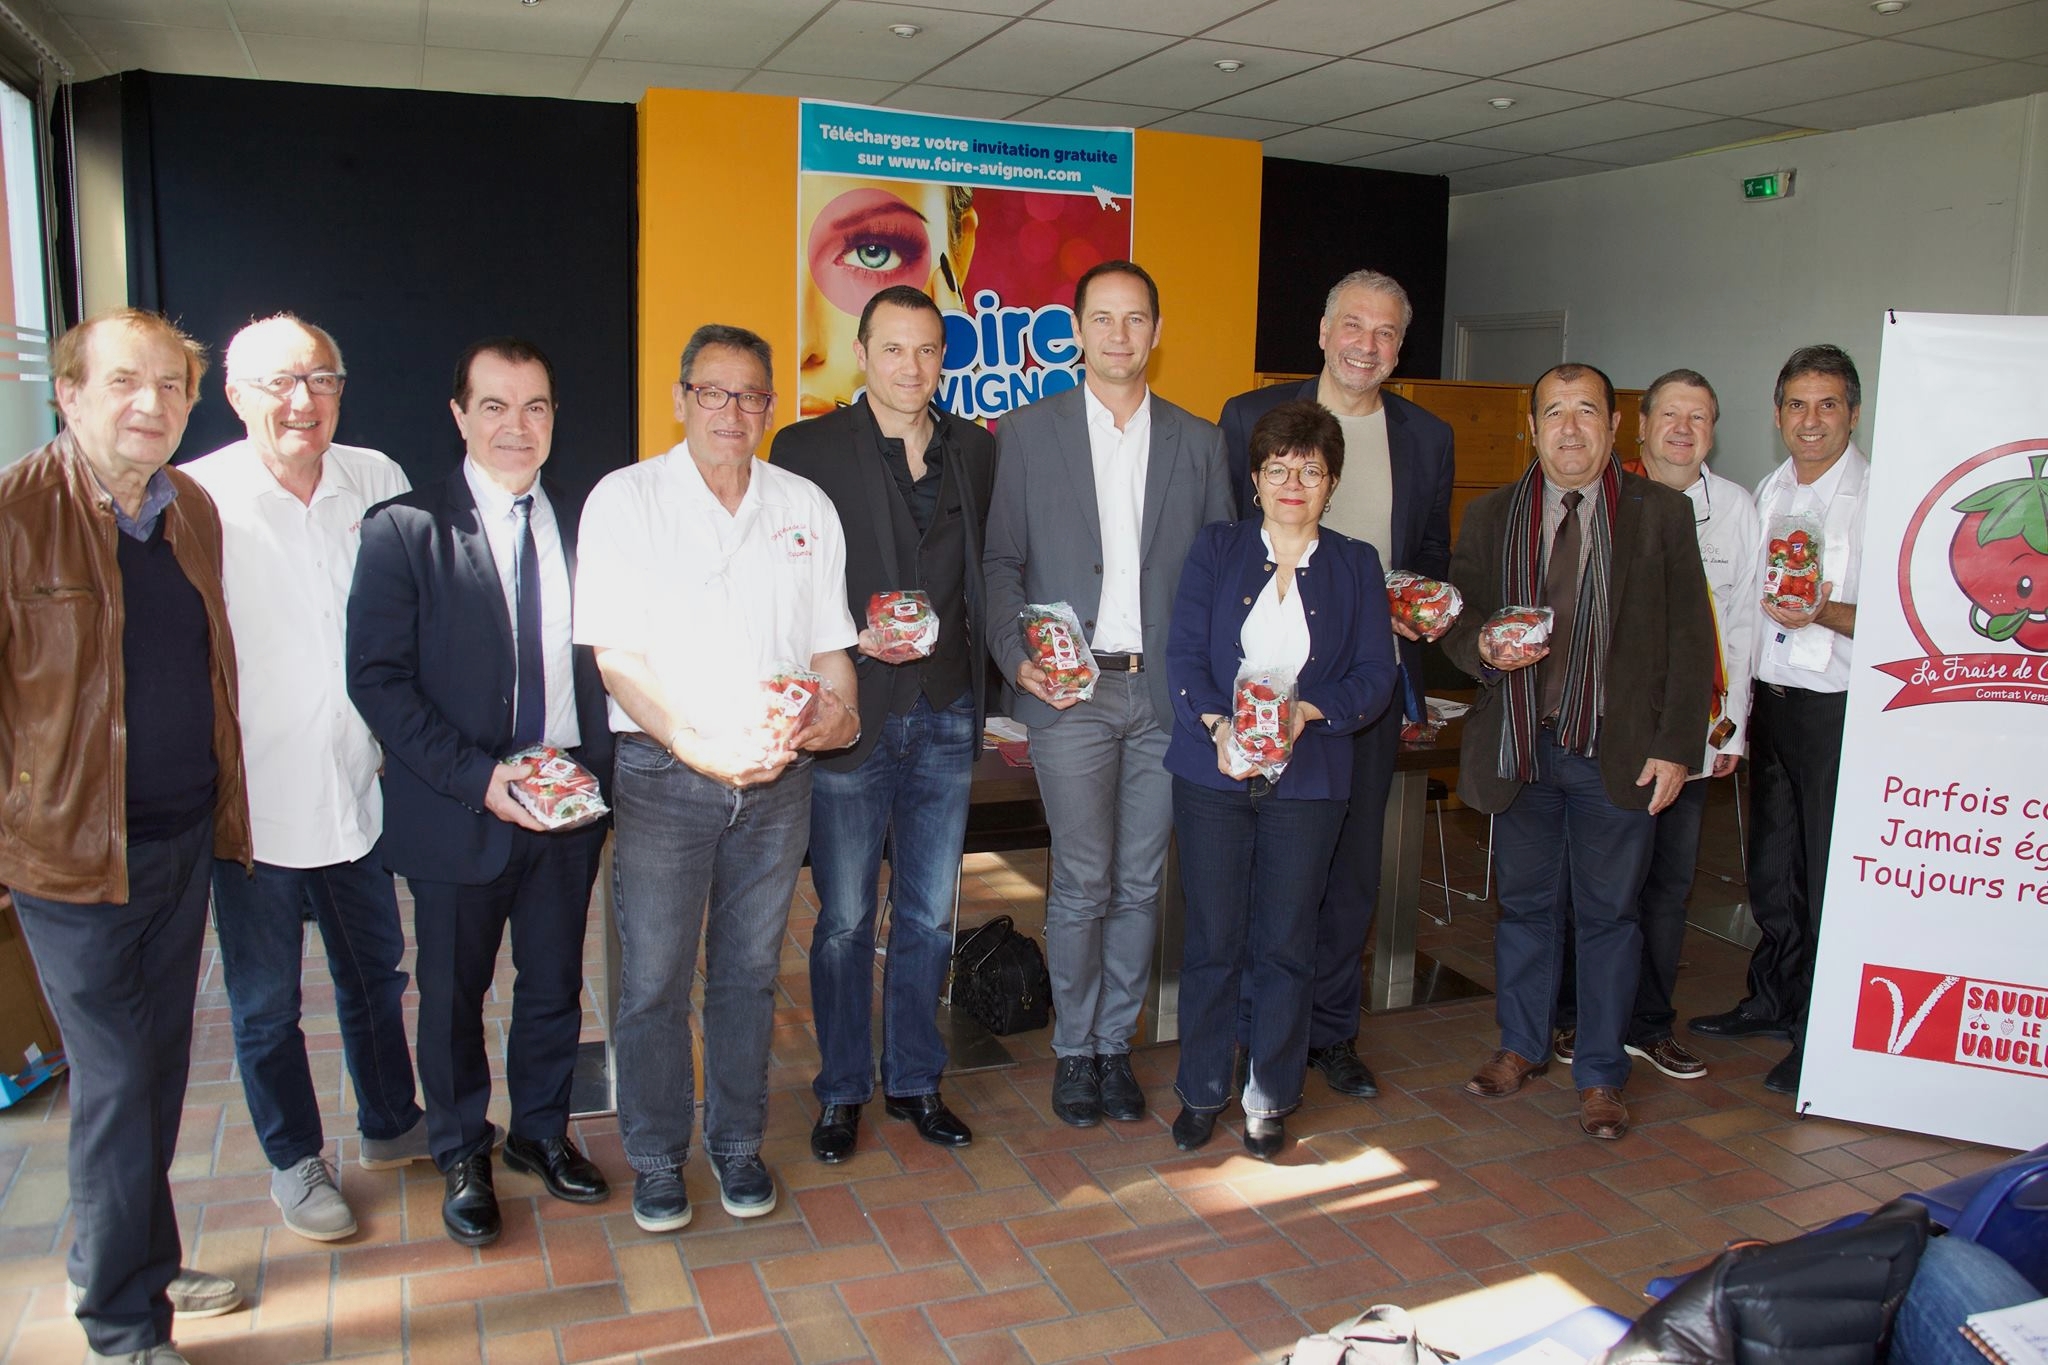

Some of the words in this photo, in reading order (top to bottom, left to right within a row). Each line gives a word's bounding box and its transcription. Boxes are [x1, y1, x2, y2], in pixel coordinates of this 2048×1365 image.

[819, 124, 921, 149] Téléchargez
[924, 136, 969, 152] votre
[972, 139, 1050, 159] invitation
[1053, 149, 1118, 164] gratuite
[857, 152, 884, 166] sur
[888, 155, 1082, 182] www.foire-avignon.com
[940, 293, 1079, 371] oire
[1910, 659, 1940, 686] La
[1942, 656, 2008, 681] Fraise
[2012, 657, 2033, 680] de
[1975, 688, 2022, 700] Comtat
[1883, 775, 2009, 816] Parfois
[1880, 818, 2002, 857] Jamais
[1852, 855, 2005, 899] Toujours
[2021, 1021, 2042, 1039] LE
[1961, 1032, 2048, 1068] VAUCL
